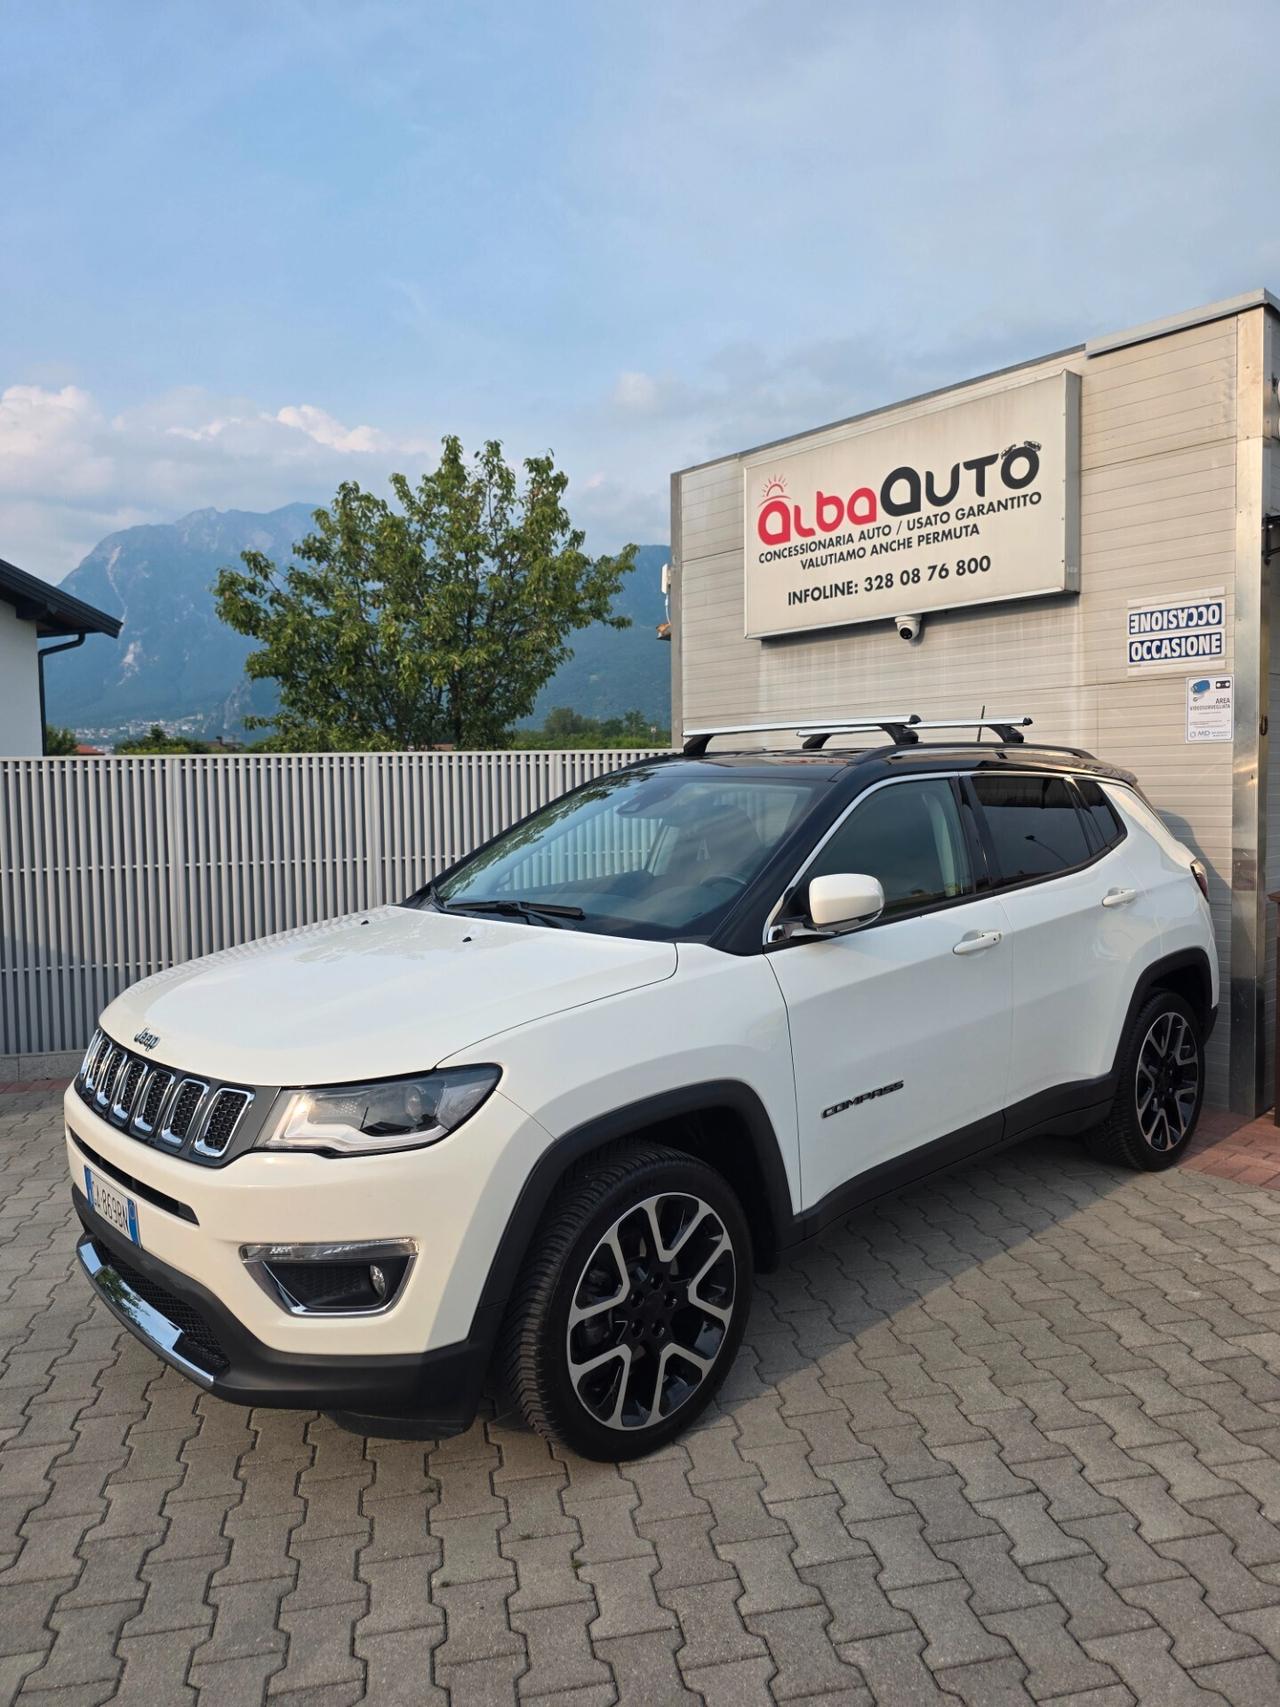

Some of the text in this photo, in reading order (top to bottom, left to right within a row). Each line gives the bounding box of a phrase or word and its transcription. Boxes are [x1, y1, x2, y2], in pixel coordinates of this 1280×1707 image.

[758, 533, 854, 564] CONCESSIONARIA
[858, 524, 892, 542] AUTO
[907, 511, 951, 531] USATO
[955, 491, 1042, 521] GARANTITO
[800, 523, 980, 570] VALUTIAMO ANCHE PERMUTA
[788, 555, 991, 606] INFOLINE: 328 08 76 800
[1130, 604, 1220, 634] OCCASIONE
[1131, 633, 1221, 661] OCCASIONE
[1215, 697, 1231, 705] AREA
[133, 1027, 161, 1052] Jeep
[822, 1080, 904, 1119] COMPASS
